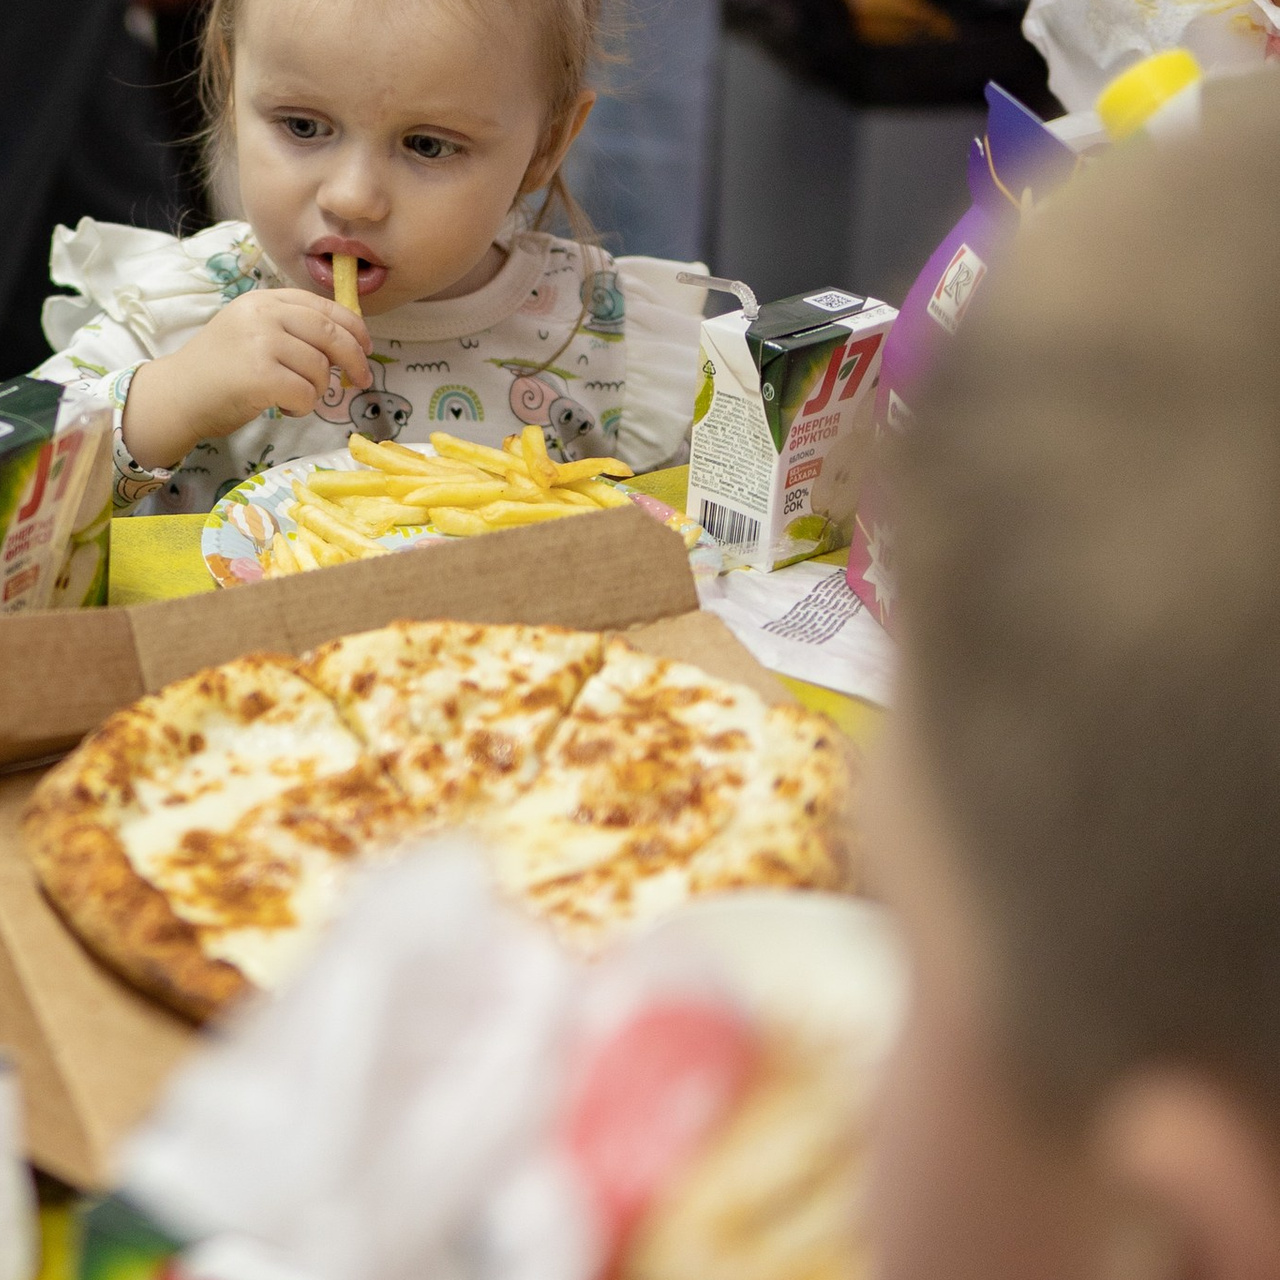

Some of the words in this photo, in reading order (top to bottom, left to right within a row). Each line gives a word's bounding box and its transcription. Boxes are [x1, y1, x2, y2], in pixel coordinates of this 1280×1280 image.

[802, 333, 883, 417] J7
[789, 425, 839, 451] ФРУКТОВ
[790, 412, 841, 438] ЭНЕРГИЯ
[17, 429, 84, 524] J7
[789, 468, 818, 485] САХАРА
[784, 499, 804, 515] СОК
[785, 488, 809, 504] 100%
